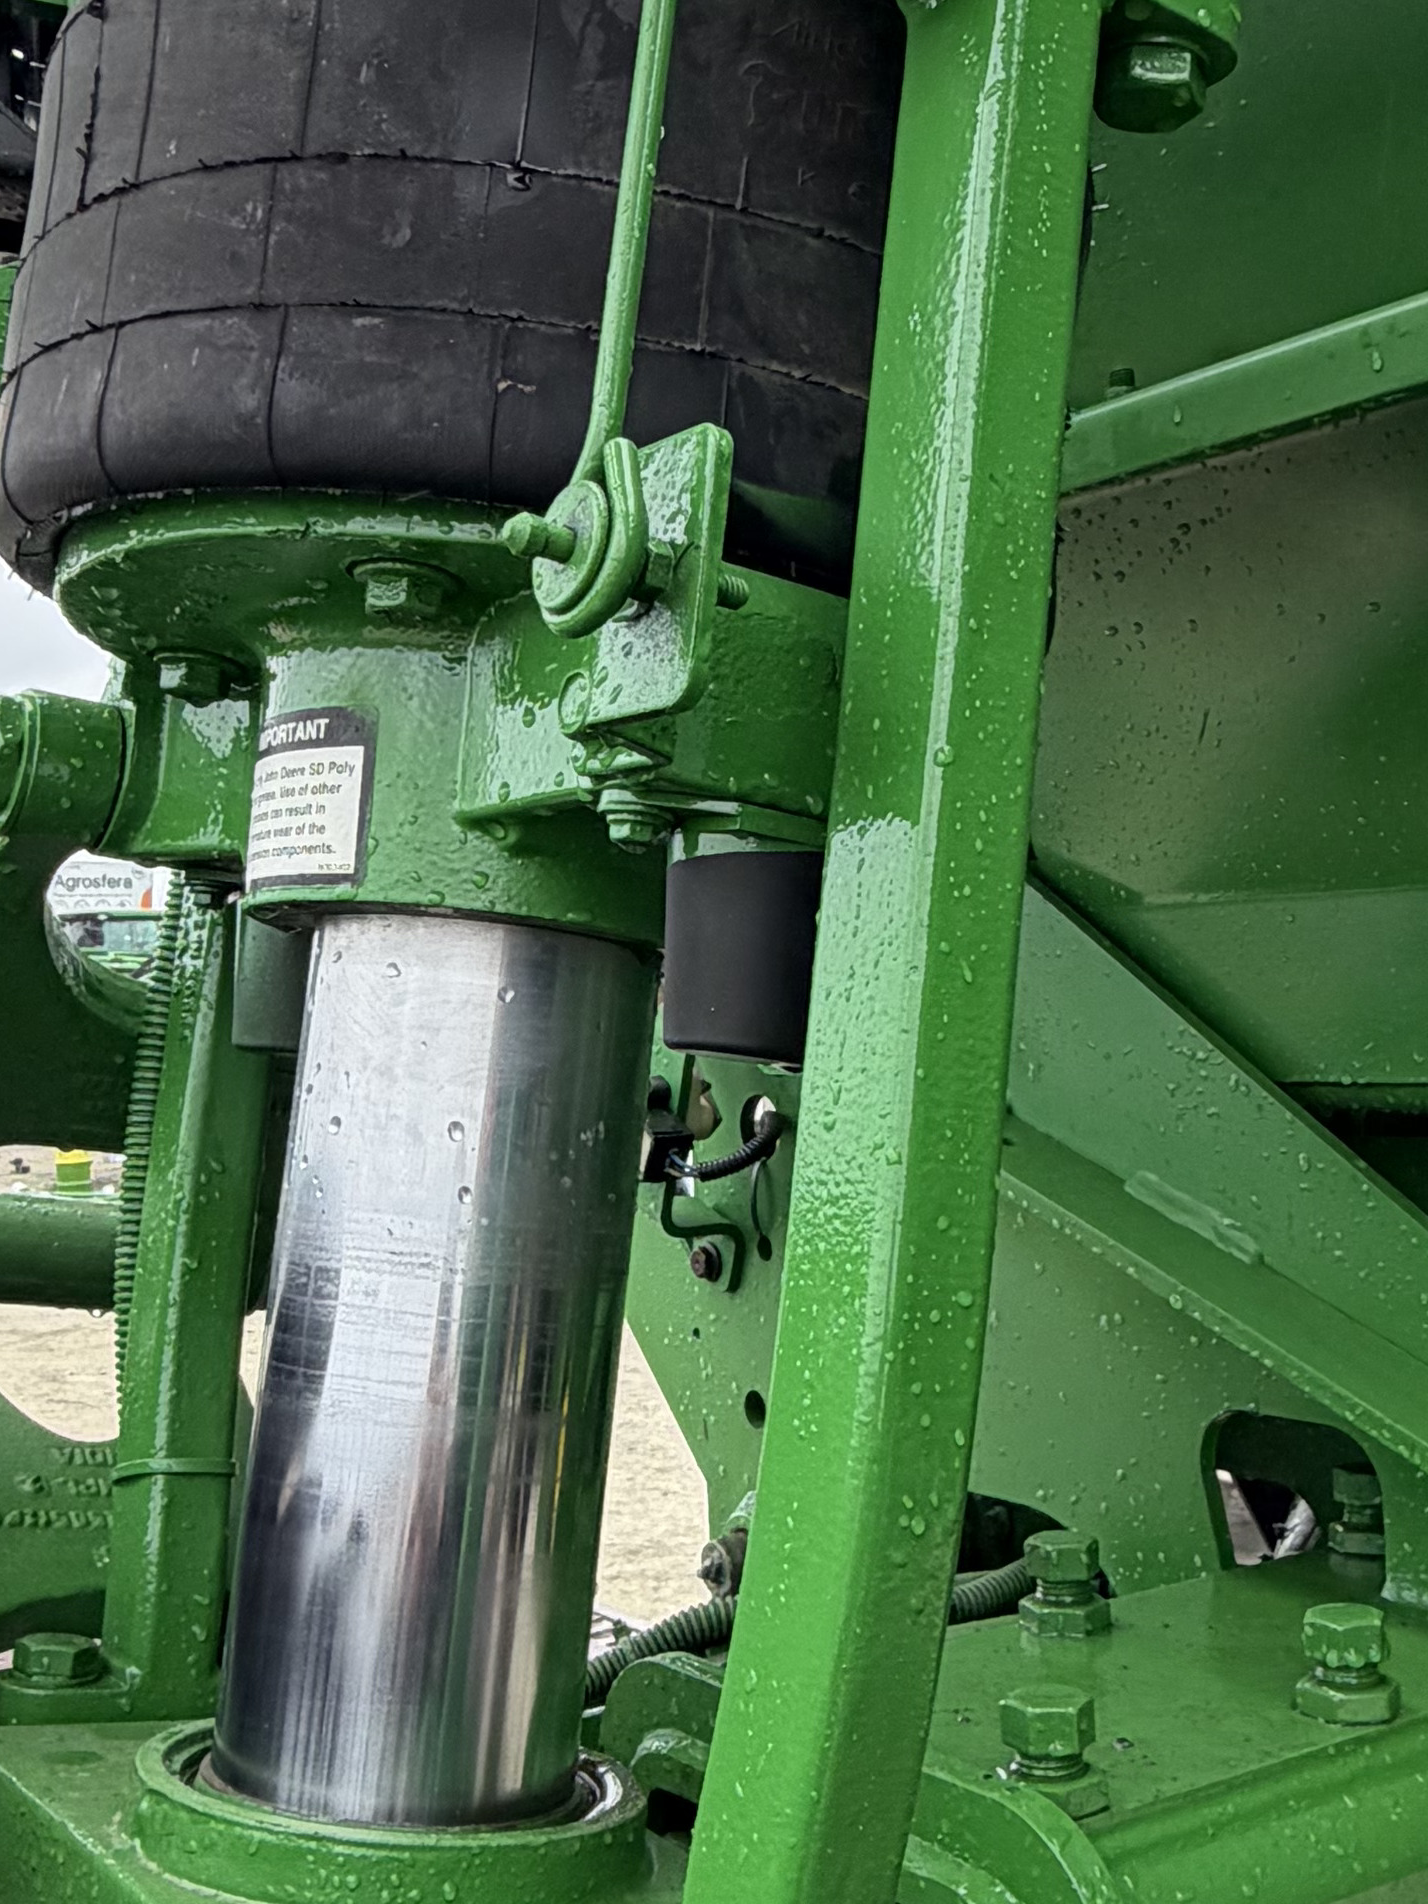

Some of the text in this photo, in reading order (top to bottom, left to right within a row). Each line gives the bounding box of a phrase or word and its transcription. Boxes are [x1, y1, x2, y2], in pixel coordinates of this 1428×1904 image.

[280, 766, 306, 780] Deere
[309, 762, 325, 776] SD
[328, 761, 355, 777] Poly
[297, 783, 309, 796] of
[310, 781, 343, 795] other
[285, 803, 313, 817] result
[315, 802, 326, 815] in
[295, 822, 306, 836] of
[308, 822, 326, 835] the
[272, 842, 337, 859] components.
[55, 874, 133, 892] Agrosfera
